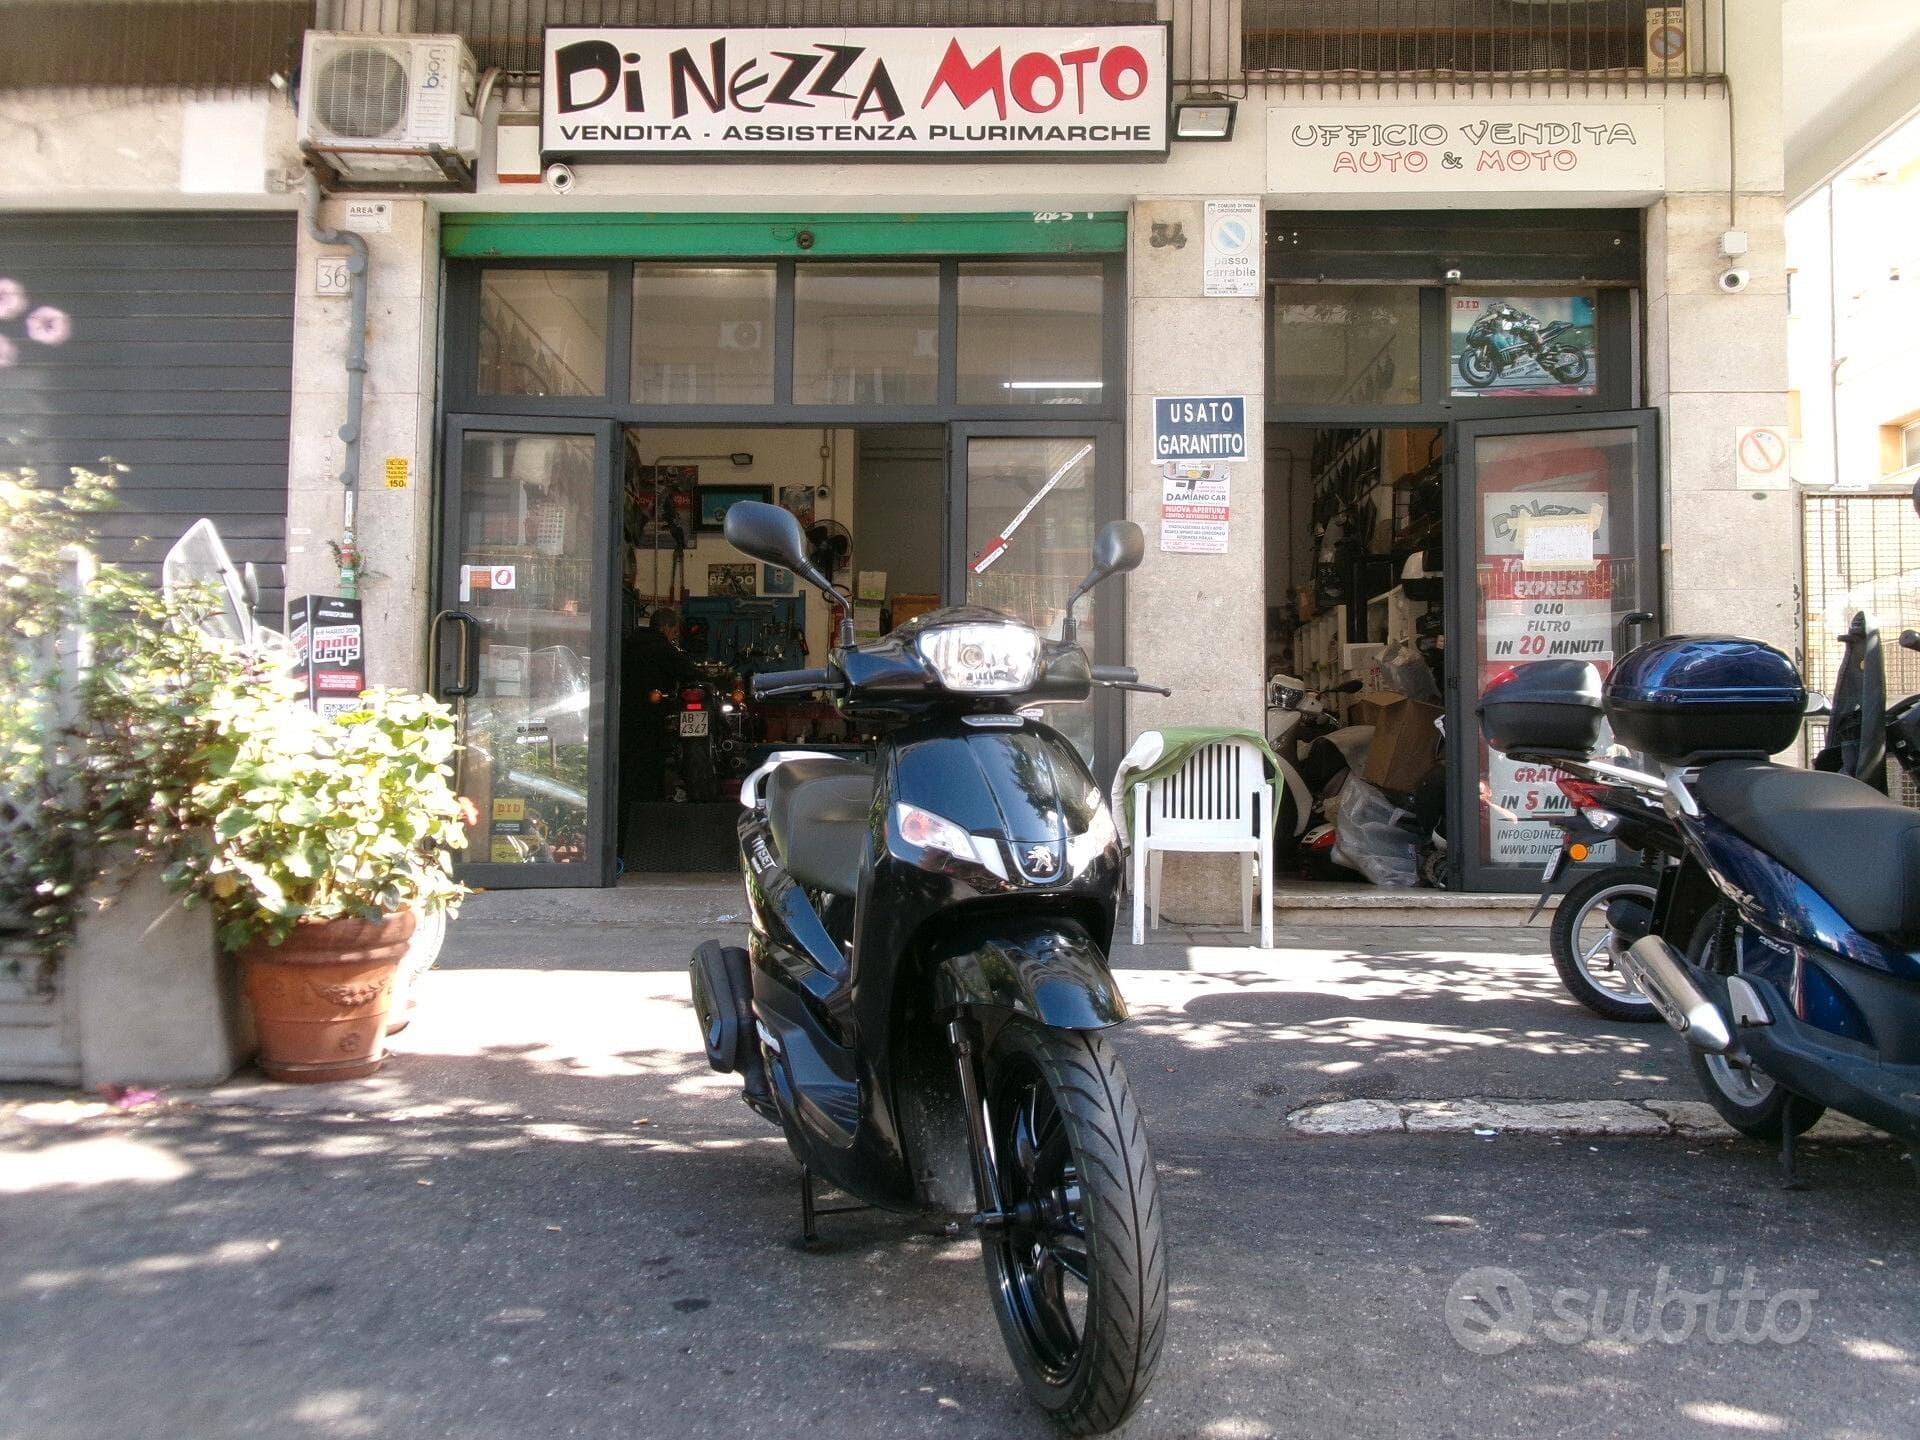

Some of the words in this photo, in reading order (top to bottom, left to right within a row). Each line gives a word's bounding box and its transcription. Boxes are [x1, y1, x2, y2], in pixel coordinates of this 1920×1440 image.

[555, 39, 645, 115] Di
[920, 36, 1148, 121] MOTO
[559, 125, 692, 141] VENDITA
[721, 125, 917, 141] ASSISTENZA
[928, 124, 1151, 141] PLURIMARCHE
[1291, 123, 1449, 147] UFFICIO
[1459, 119, 1637, 146] VENDITA
[1333, 150, 1428, 173] AUTO
[1440, 151, 1464, 170] &
[1476, 149, 1578, 172] MOTO
[349, 206, 374, 214] AREA
[1215, 257, 1249, 267] passo
[318, 263, 348, 288] 36
[1206, 267, 1257, 277] carrabile
[1170, 402, 1233, 423] USATO
[1158, 433, 1243, 455] GARANTITO
[1166, 493, 1210, 501] DAMIANO
[1514, 581, 1584, 597] EXPRESS
[1534, 603, 1564, 614] OLIO
[1527, 620, 1571, 632] FILTRO
[315, 635, 358, 649] moto
[1495, 641, 1513, 654] IN
[1519, 635, 1546, 655] 20
[1549, 640, 1604, 654] MINUTI
[315, 648, 358, 663] days
[1501, 795, 1518, 809] IN
[1525, 790, 1539, 810] 5
